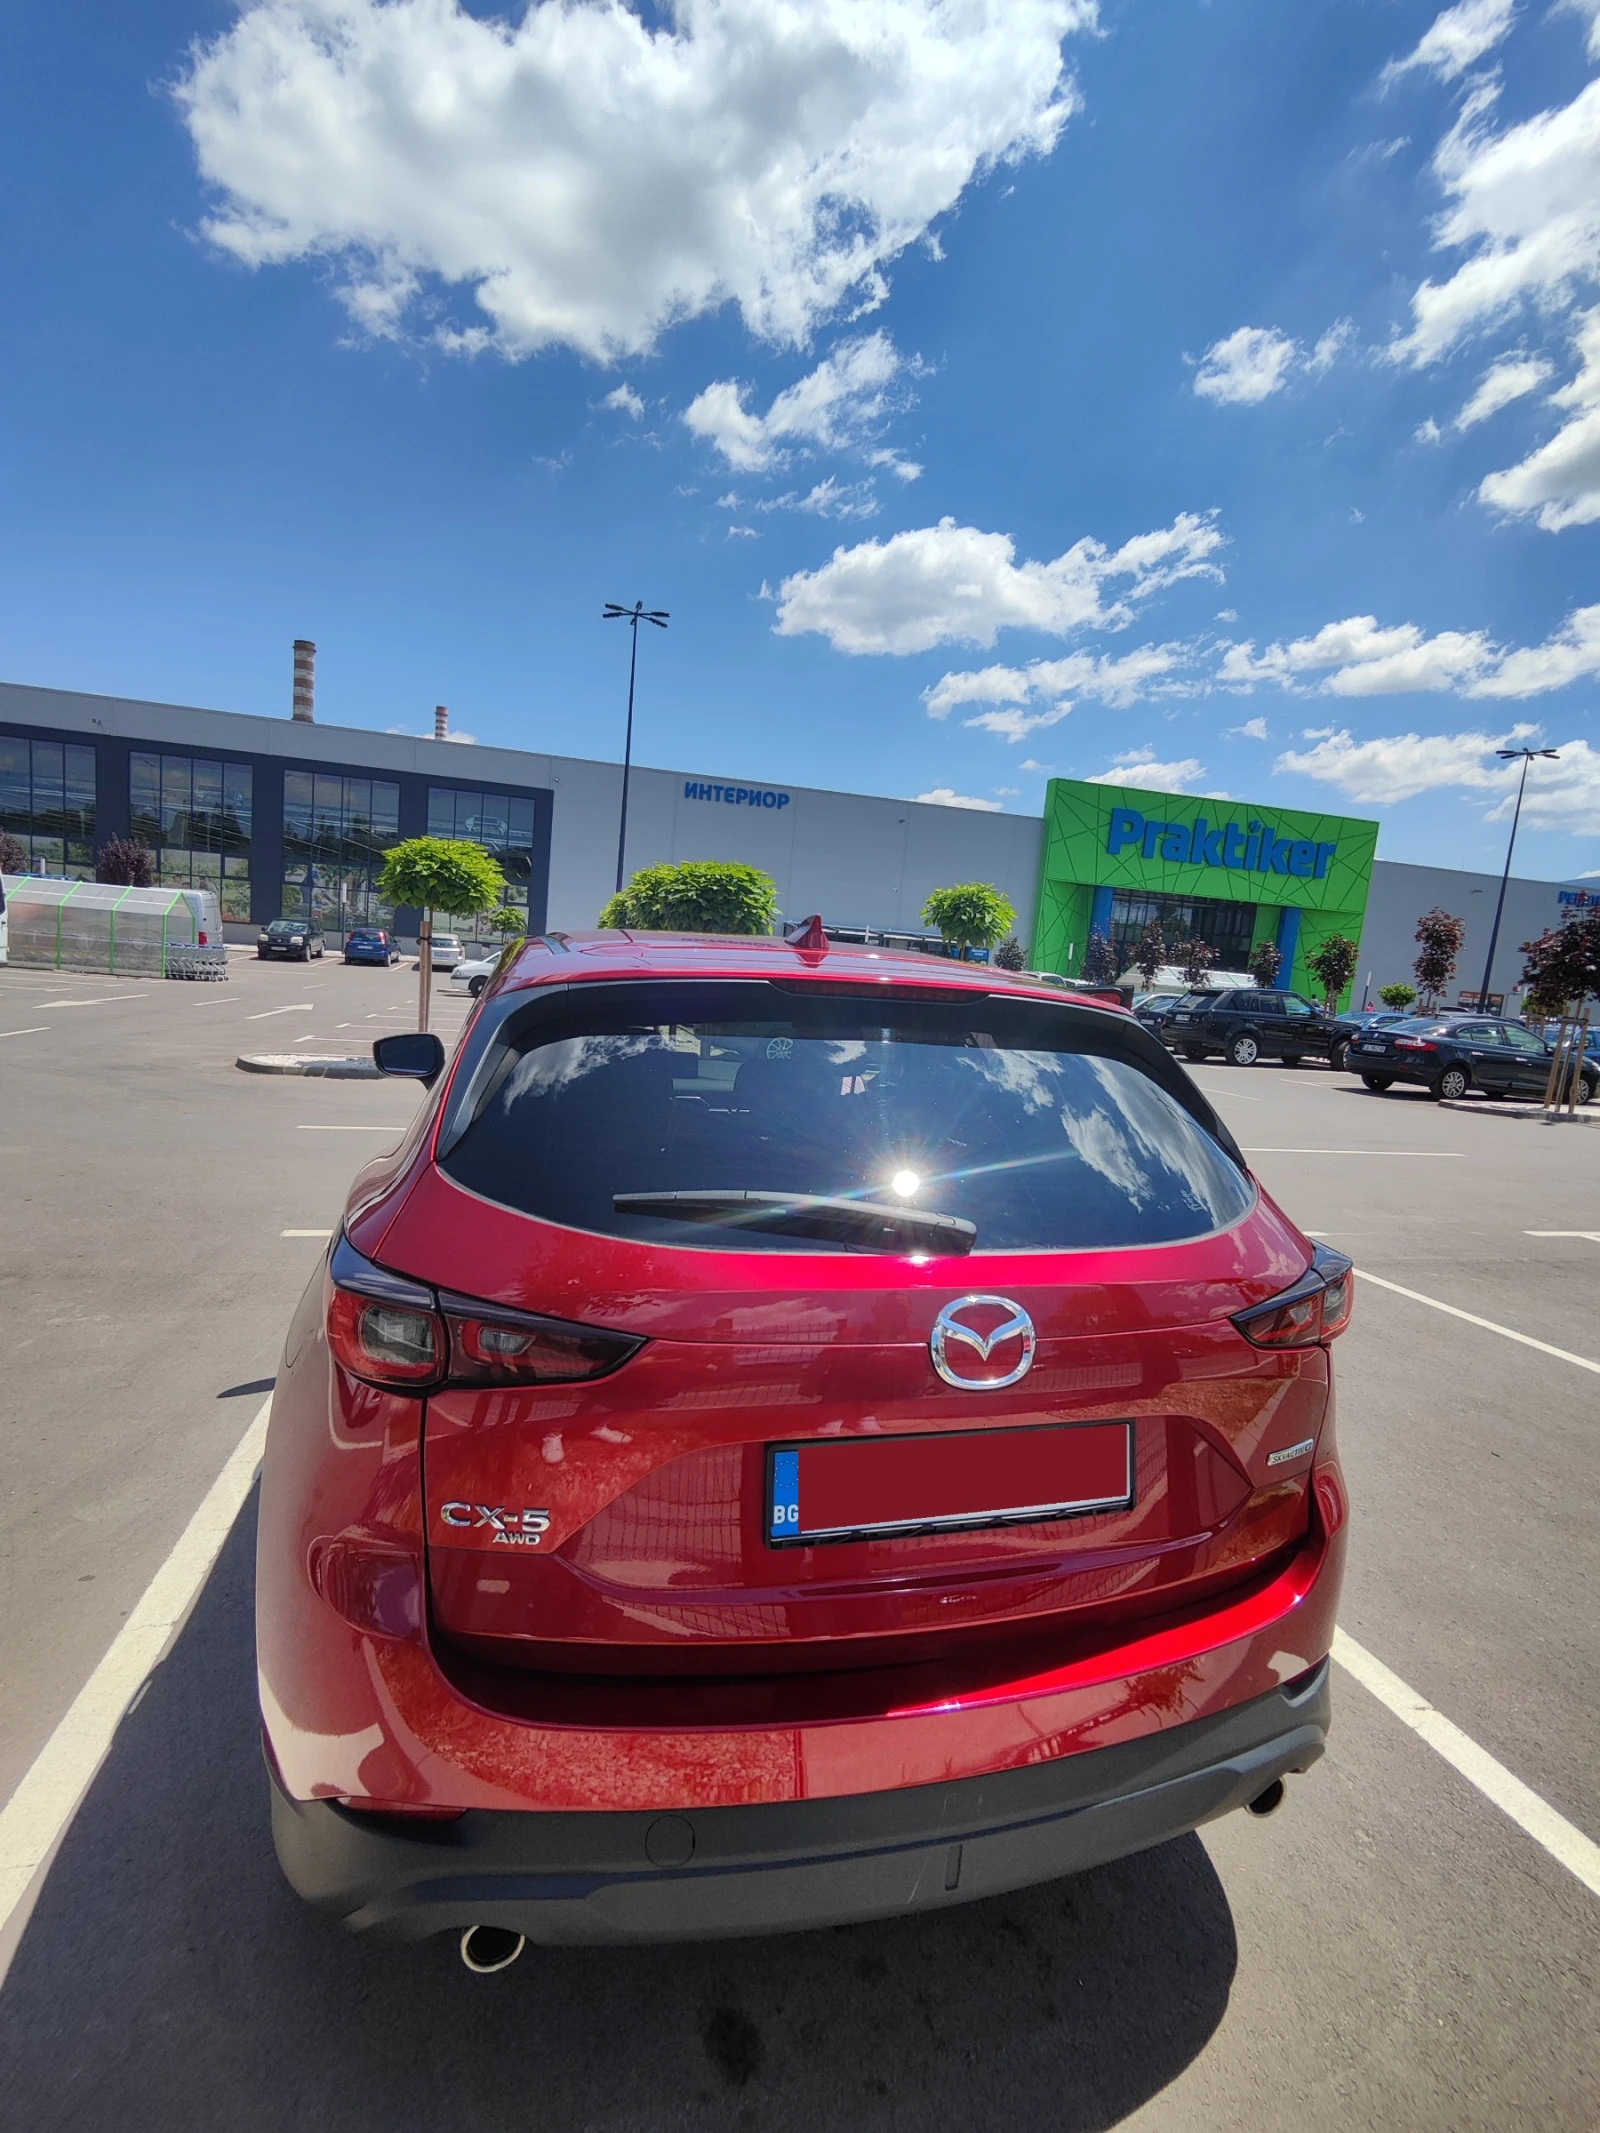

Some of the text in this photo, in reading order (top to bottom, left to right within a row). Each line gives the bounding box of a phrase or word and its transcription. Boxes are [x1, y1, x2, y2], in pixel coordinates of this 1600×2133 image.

[684, 781, 790, 810] ИНТЕРИОР
[1107, 807, 1337, 879] Praktiker
[440, 1501, 551, 1532] CX-5
[773, 1504, 799, 1524] BG
[492, 1531, 541, 1546] AWD
